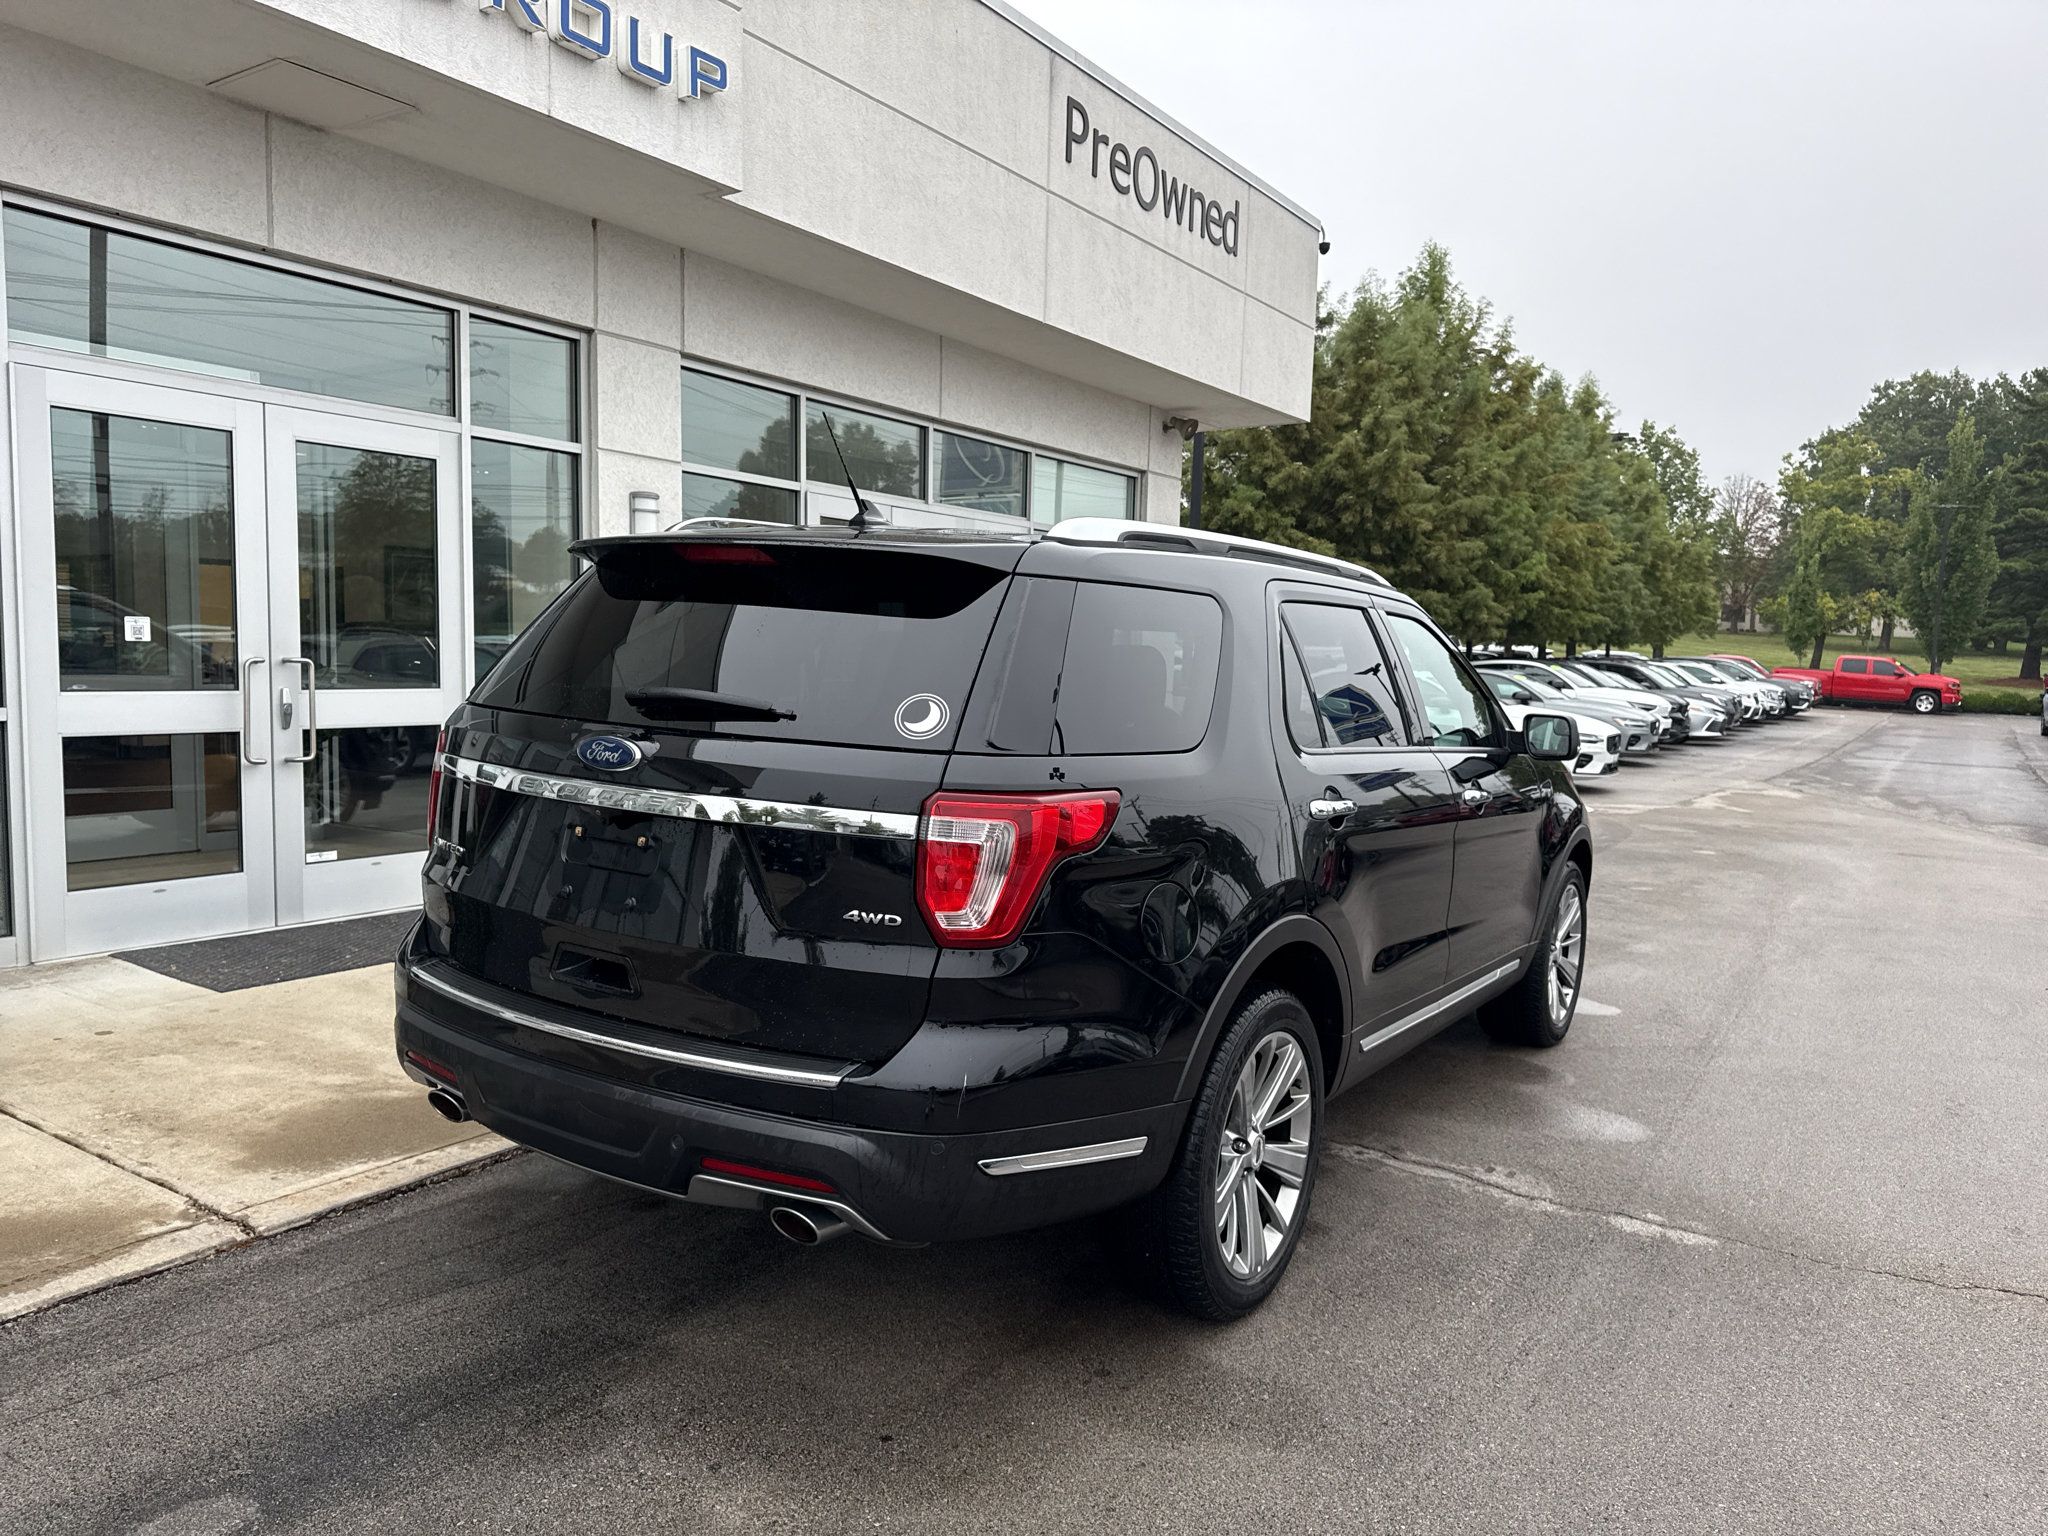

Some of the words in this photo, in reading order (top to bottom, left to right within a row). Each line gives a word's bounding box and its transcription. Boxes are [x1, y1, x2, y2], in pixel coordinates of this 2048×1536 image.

[1065, 95, 1240, 257] PreOwned
[586, 740, 623, 763] Ford
[518, 775, 695, 817] EXPLORER
[842, 909, 903, 927] 4WD
